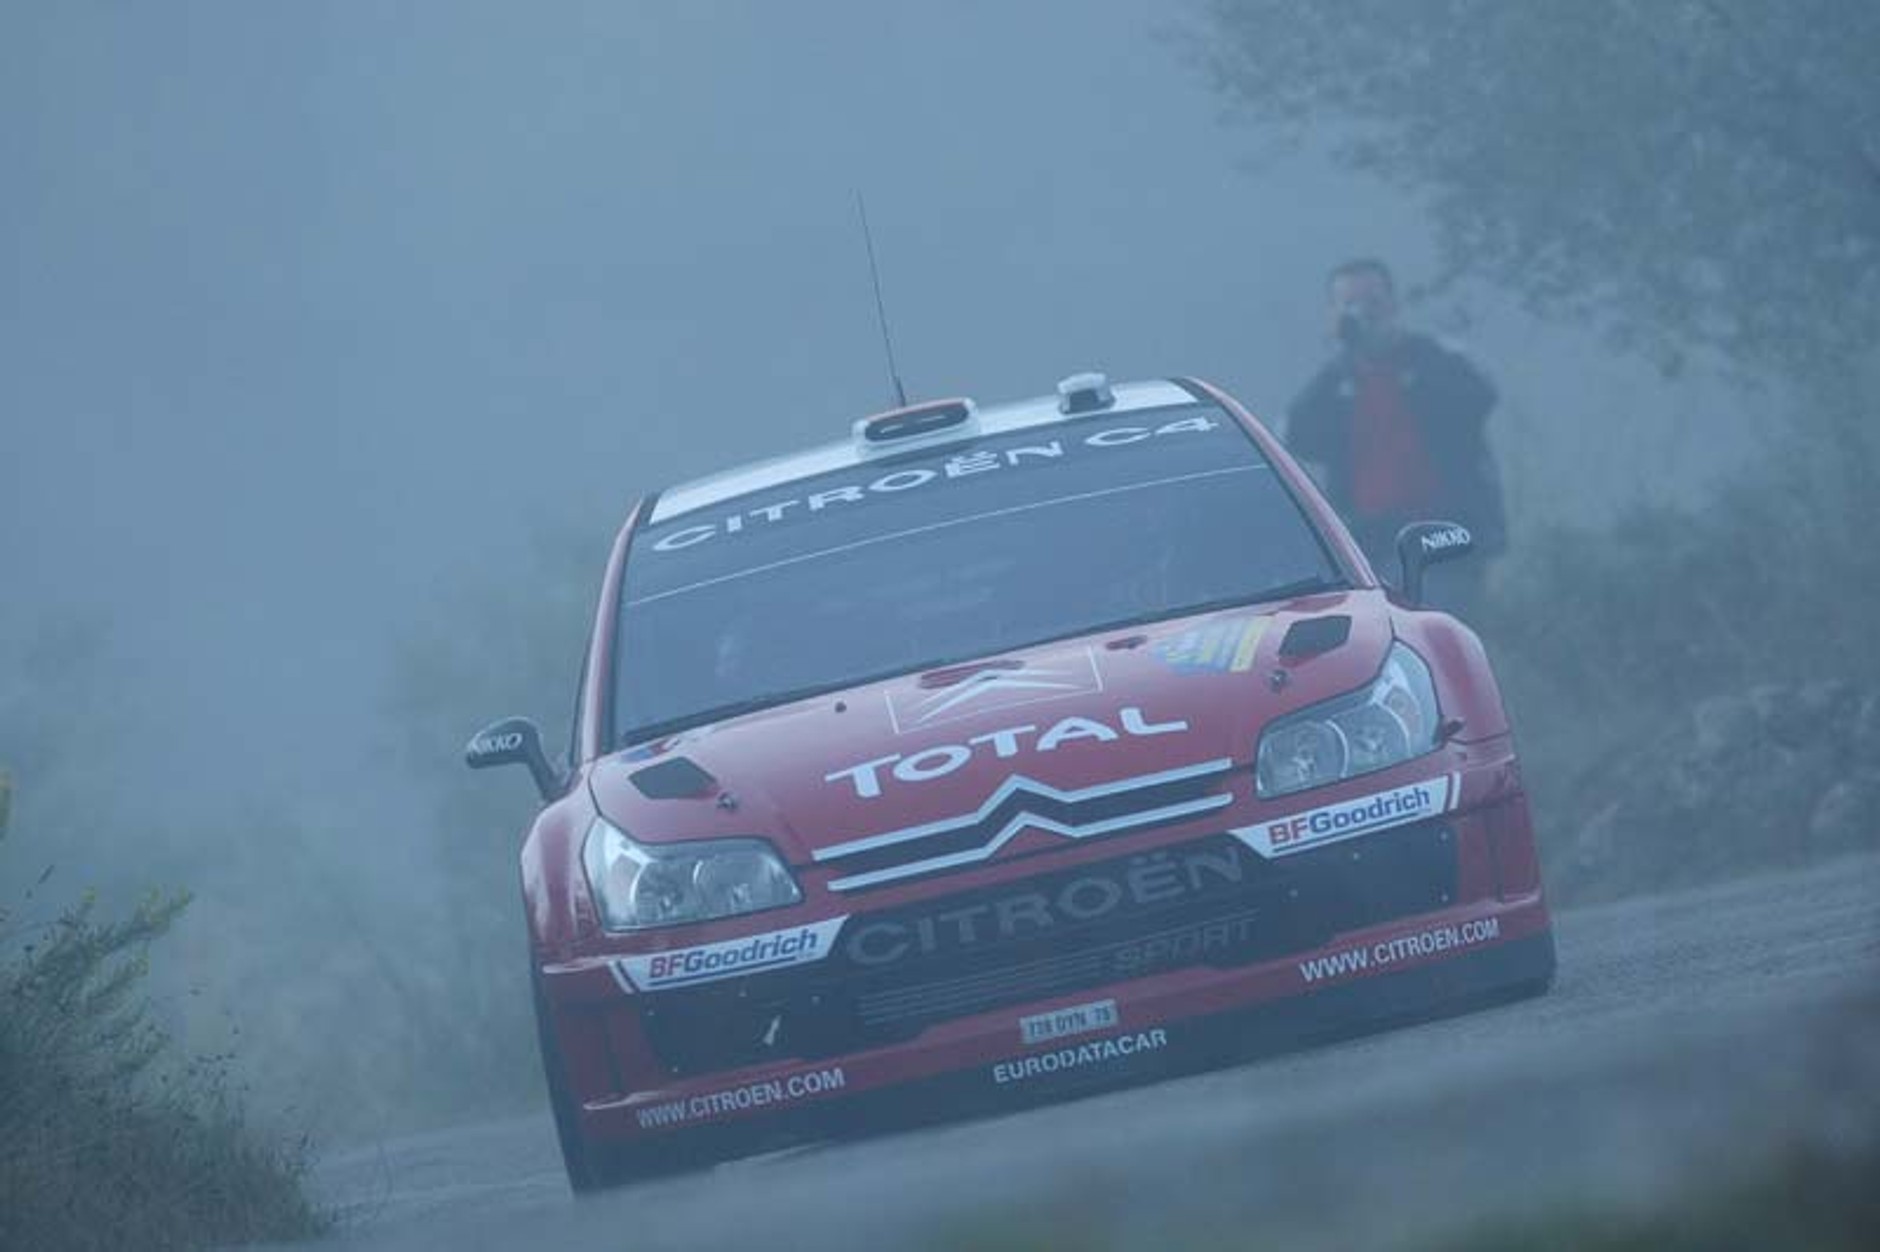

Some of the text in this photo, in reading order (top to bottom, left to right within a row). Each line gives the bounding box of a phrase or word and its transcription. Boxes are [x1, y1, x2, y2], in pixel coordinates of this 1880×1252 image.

[652, 416, 1218, 551] CITROËN C4
[825, 706, 1188, 799] TOTAL
[1267, 786, 1430, 846] BFGoodrich
[846, 845, 1242, 966] CITROËN
[648, 928, 817, 979] BFGoodrich
[1112, 915, 1257, 973] SPORT
[993, 1029, 1168, 1083] EURODATACAR
